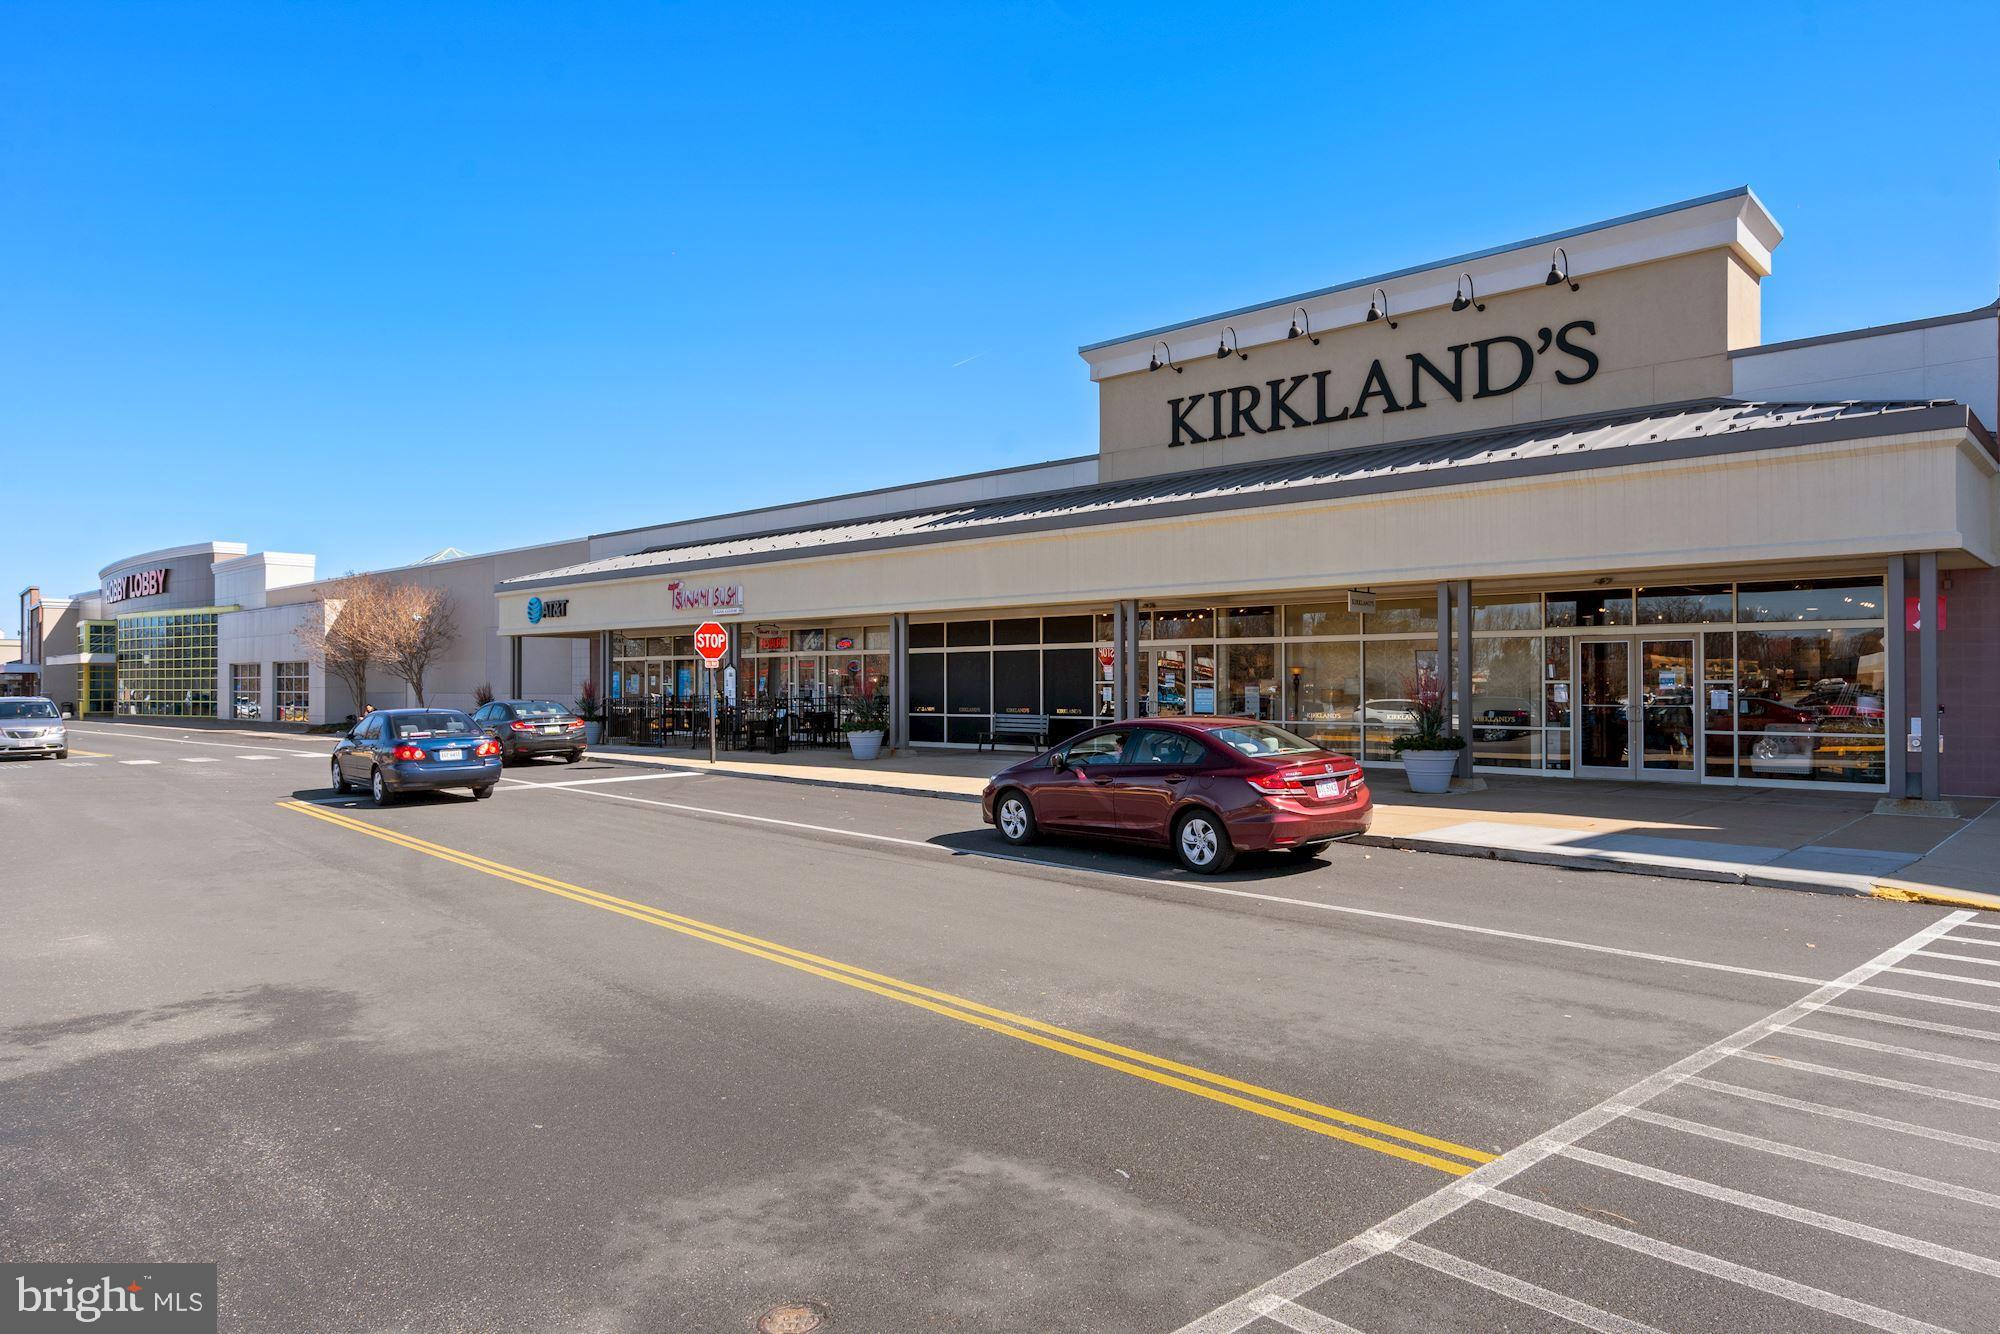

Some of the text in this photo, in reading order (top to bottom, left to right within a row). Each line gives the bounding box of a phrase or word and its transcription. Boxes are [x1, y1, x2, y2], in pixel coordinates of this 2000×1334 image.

[1168, 320, 1600, 448] KIRKLAND'S
[106, 568, 166, 604] HOBBY LOBBY
[667, 580, 744, 609] TSUNAMI SUSHI
[543, 600, 569, 618] AT&T
[697, 633, 726, 648] STOP
